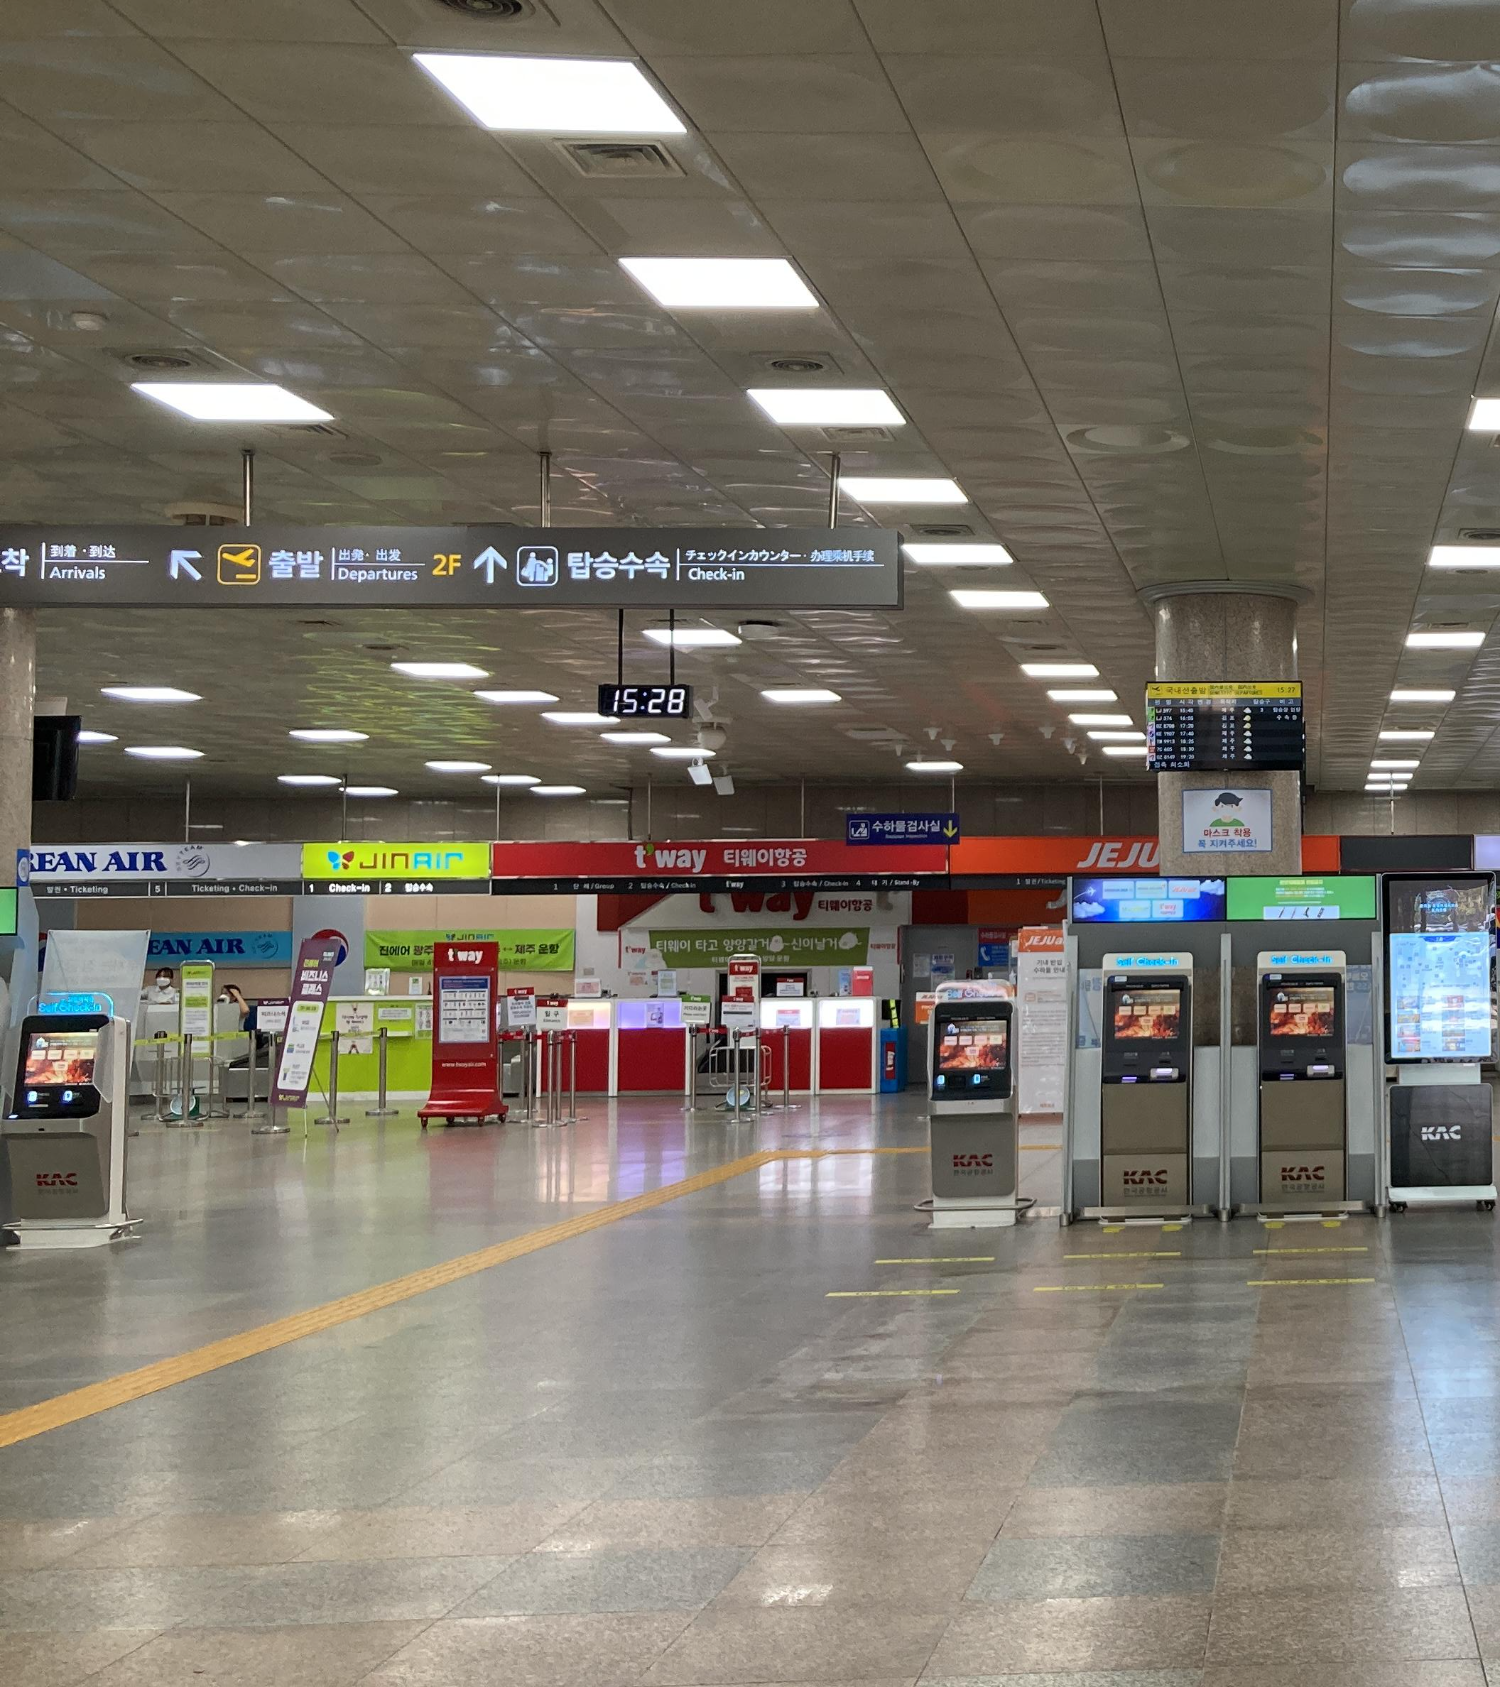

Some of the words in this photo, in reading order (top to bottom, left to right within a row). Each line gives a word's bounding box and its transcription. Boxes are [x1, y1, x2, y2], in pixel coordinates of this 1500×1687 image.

[0, 548, 29, 577] 착
[269, 550, 324, 579] 출발
[433, 554, 461, 576] 2F
[567, 551, 670, 580] 탑승수속
[49, 567, 106, 580] Arrivals
[338, 568, 418, 583] Departures
[688, 567, 745, 581] Check-in
[611, 688, 686, 714] 15:28
[872, 820, 940, 832] 수하물검사실
[1203, 829, 1230, 837] 마스크
[1234, 828, 1252, 837] 착용
[1210, 839, 1257, 848] 지켜주세요!
[102, 851, 168, 872] AIR
[723, 848, 808, 867] 티웨이항공
[1077, 842, 1159, 868] JEJU
[70, 885, 109, 894] Ticketing
[191, 884, 230, 893] Ticketing
[238, 883, 278, 892] Check-in
[309, 884, 314, 892] 1
[328, 883, 371, 893] Check-in
[384, 883, 392, 892] 2
[818, 899, 873, 912] 티웨이항공
[149, 938, 195, 956] EAN
[197, 938, 245, 954] AIR
[379, 945, 410, 956] 진에어
[515, 944, 536, 954] 제주
[538, 944, 559, 954] 운항
[656, 939, 691, 953] 티웨이
[695, 939, 718, 952] 타고
[301, 970, 328, 981] 비즈니스
[1421, 1125, 1461, 1140] KAC
[952, 1154, 993, 1167] KAC
[36, 1173, 78, 1186] KAC
[1123, 1169, 1168, 1185] KAC
[1281, 1166, 1325, 1181] KAC
